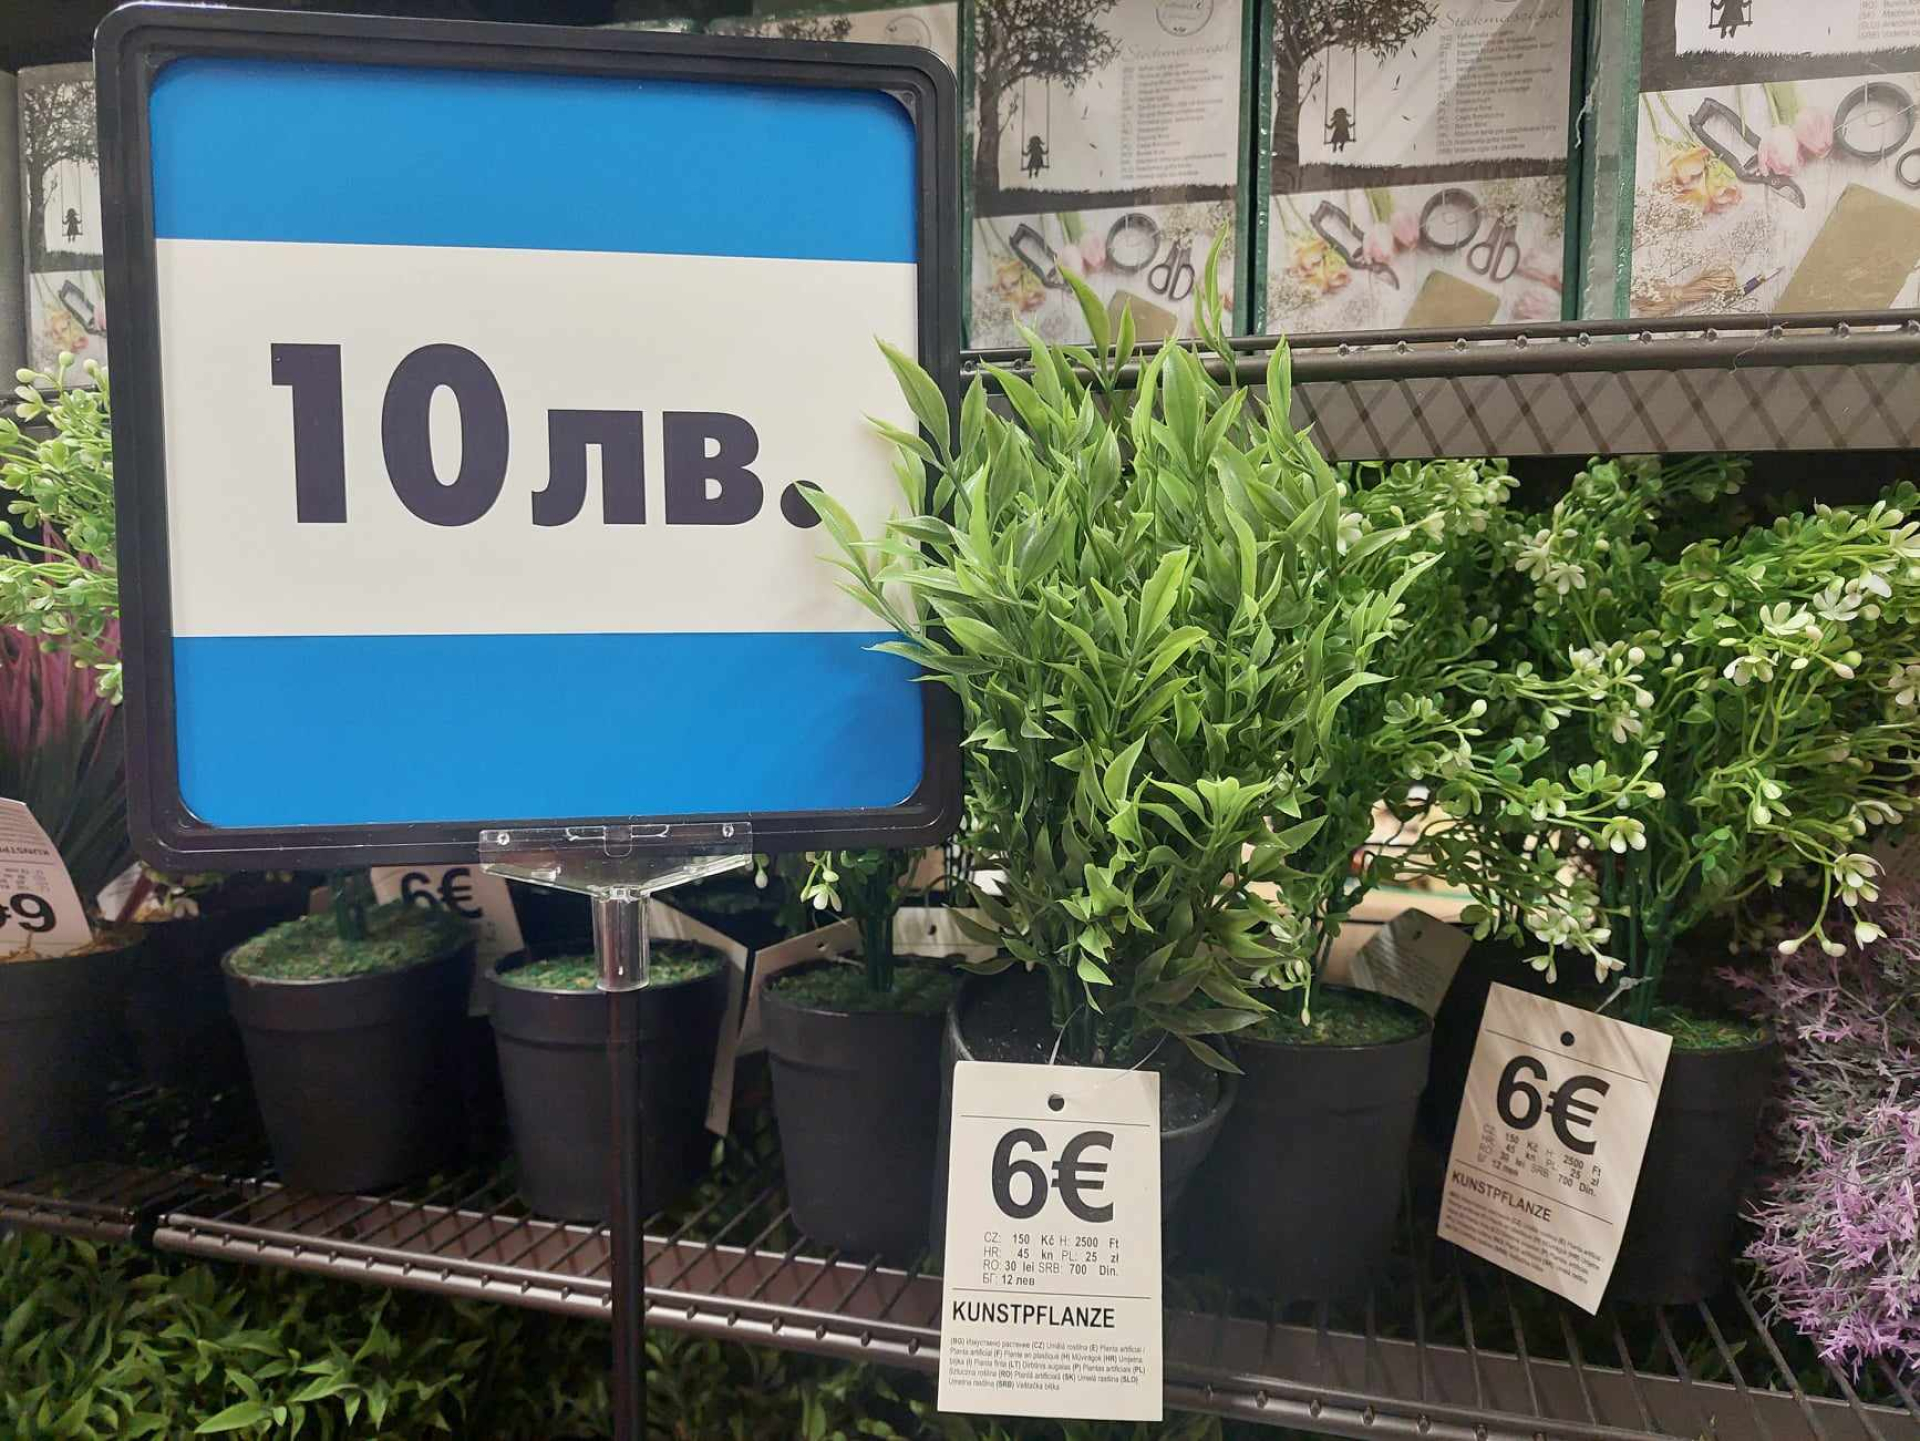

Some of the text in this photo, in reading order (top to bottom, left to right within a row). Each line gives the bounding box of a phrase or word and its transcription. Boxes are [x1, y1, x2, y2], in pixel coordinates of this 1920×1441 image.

[270, 342, 824, 529] 10 лв.
[1496, 1055, 1611, 1155] 6€
[1562, 1154, 1584, 1169] 2500
[1592, 1165, 1601, 1177] Ft
[1570, 1168, 1581, 1179] 25
[991, 1128, 1115, 1223] 6€
[1559, 1173, 1573, 1187] 700
[1579, 1182, 1597, 1196] Din.
[1452, 1169, 1551, 1222] KUNSTPFLANZE
[984, 1232, 1001, 1243] CZ:
[1013, 1233, 1030, 1245] 150
[1041, 1234, 1054, 1246] Kč
[1075, 1236, 1098, 1248] 2500
[1109, 1237, 1119, 1249] Ft
[1017, 1248, 1029, 1259] 45
[1041, 1249, 1053, 1260] kn
[1085, 1251, 1097, 1262] 25
[1004, 1260, 1017, 1271] 30
[1023, 1261, 1035, 1272] lei
[1069, 1263, 1087, 1275] 700
[1099, 1264, 1119, 1276] Din.
[1002, 1274, 1013, 1285] 12
[1016, 1276, 1035, 1286] лев
[952, 1301, 1115, 1328] KUNSTPFLANZE
[1032, 1340, 1045, 1349] (CZ)
[999, 1370, 1012, 1379] (RO)
[1008, 1360, 1020, 1369] (LT)
[1133, 1365, 1146, 1374] (PL)
